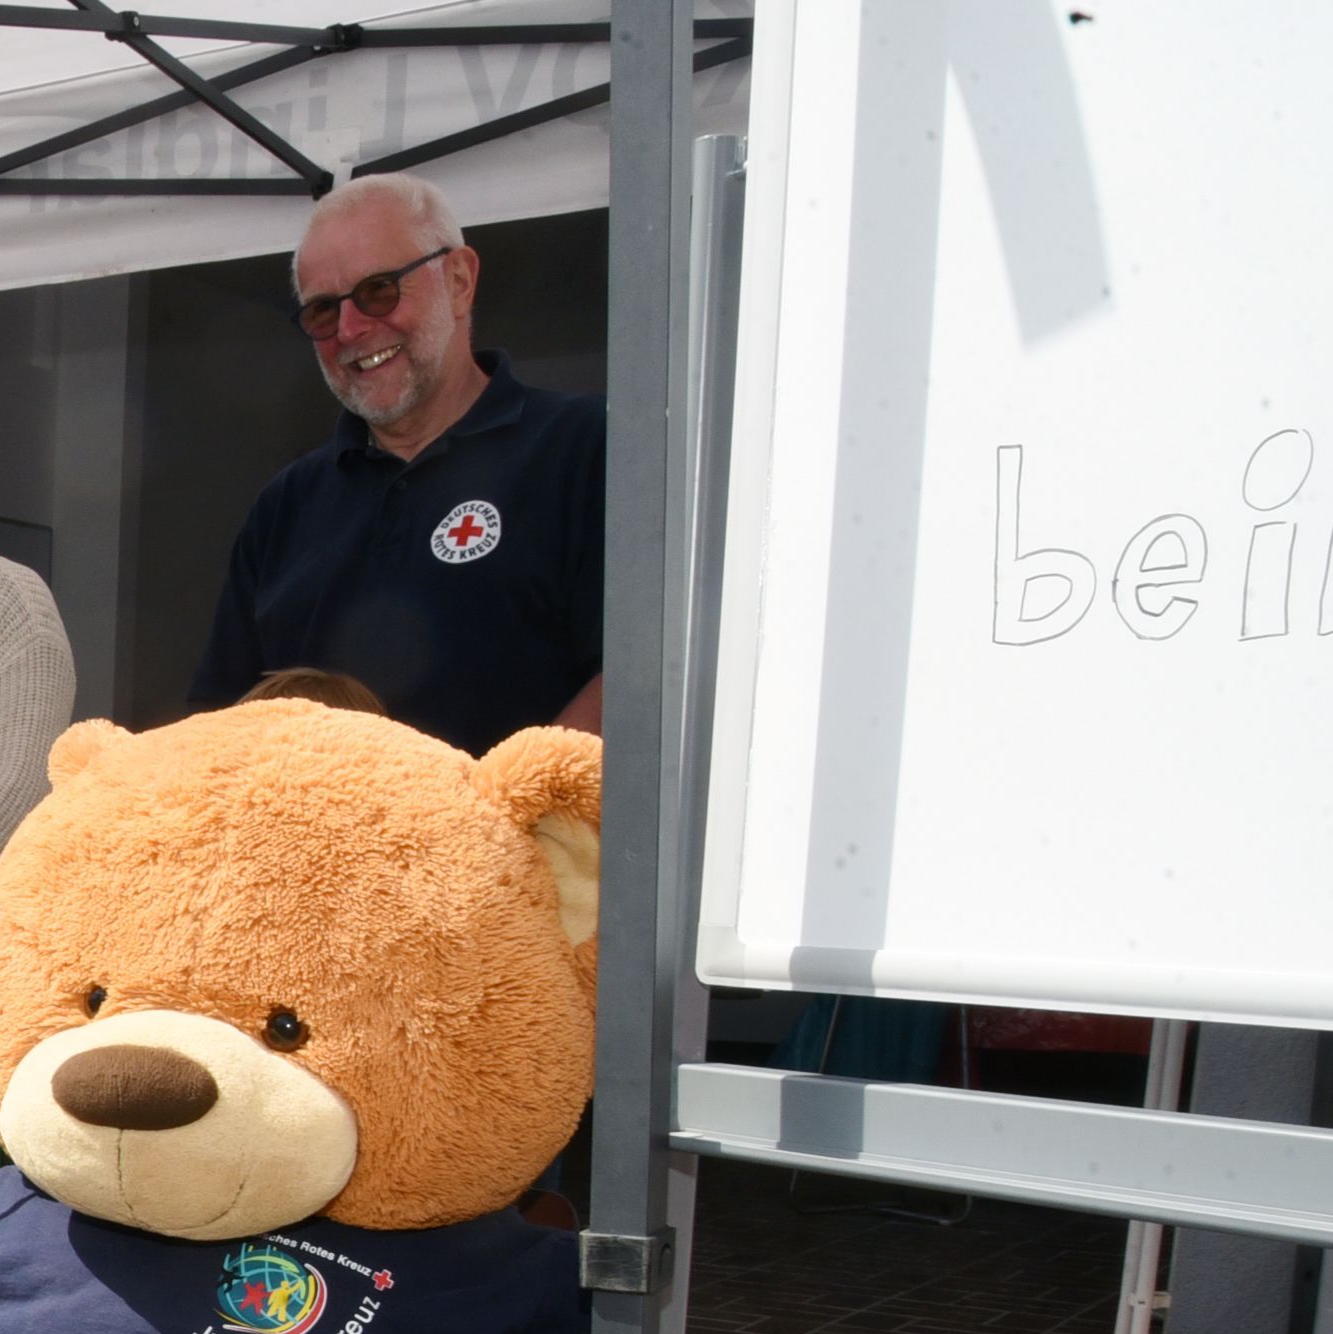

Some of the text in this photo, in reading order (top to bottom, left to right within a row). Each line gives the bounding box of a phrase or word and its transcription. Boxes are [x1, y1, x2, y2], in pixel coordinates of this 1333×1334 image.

[440, 503, 498, 529] DEUTSCHES
[433, 532, 497, 560] ROTES KREUZ
[299, 1240, 336, 1262] Rotes
[337, 1253, 373, 1277] Kreuz
